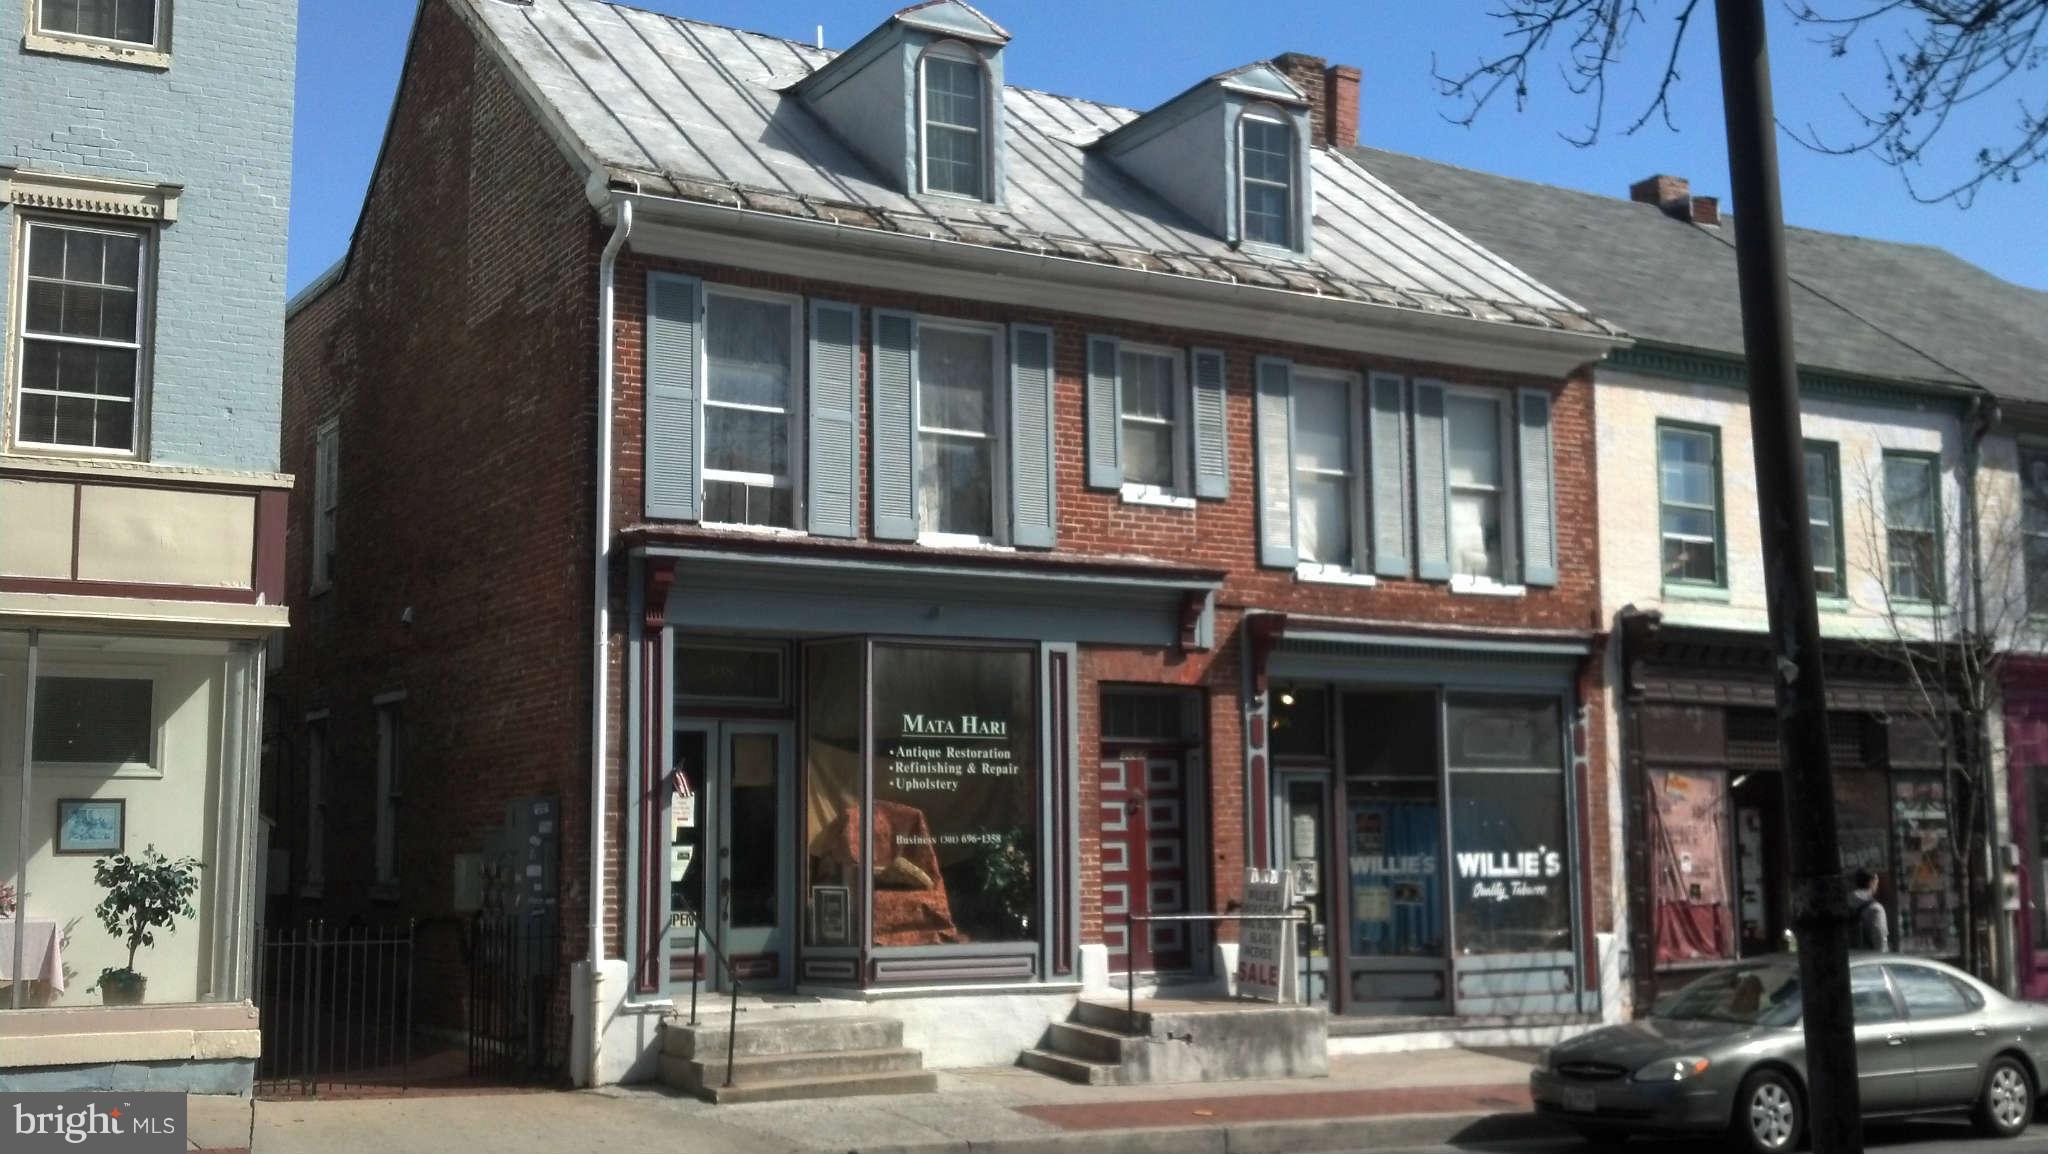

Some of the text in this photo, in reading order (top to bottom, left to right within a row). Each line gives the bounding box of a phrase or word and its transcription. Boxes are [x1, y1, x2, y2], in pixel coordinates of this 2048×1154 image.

[902, 714, 1007, 735] MATA HARI
[896, 746, 1011, 760] Antique Restoration
[895, 762, 1019, 776] Refinishing & Repair
[896, 778, 959, 791] Upholstery
[896, 834, 937, 845] Business
[1350, 853, 1436, 874] WILLIE'S
[1457, 845, 1561, 877] WILLIE'S
[671, 912, 696, 926] PEN
[1238, 961, 1279, 986] SALE
